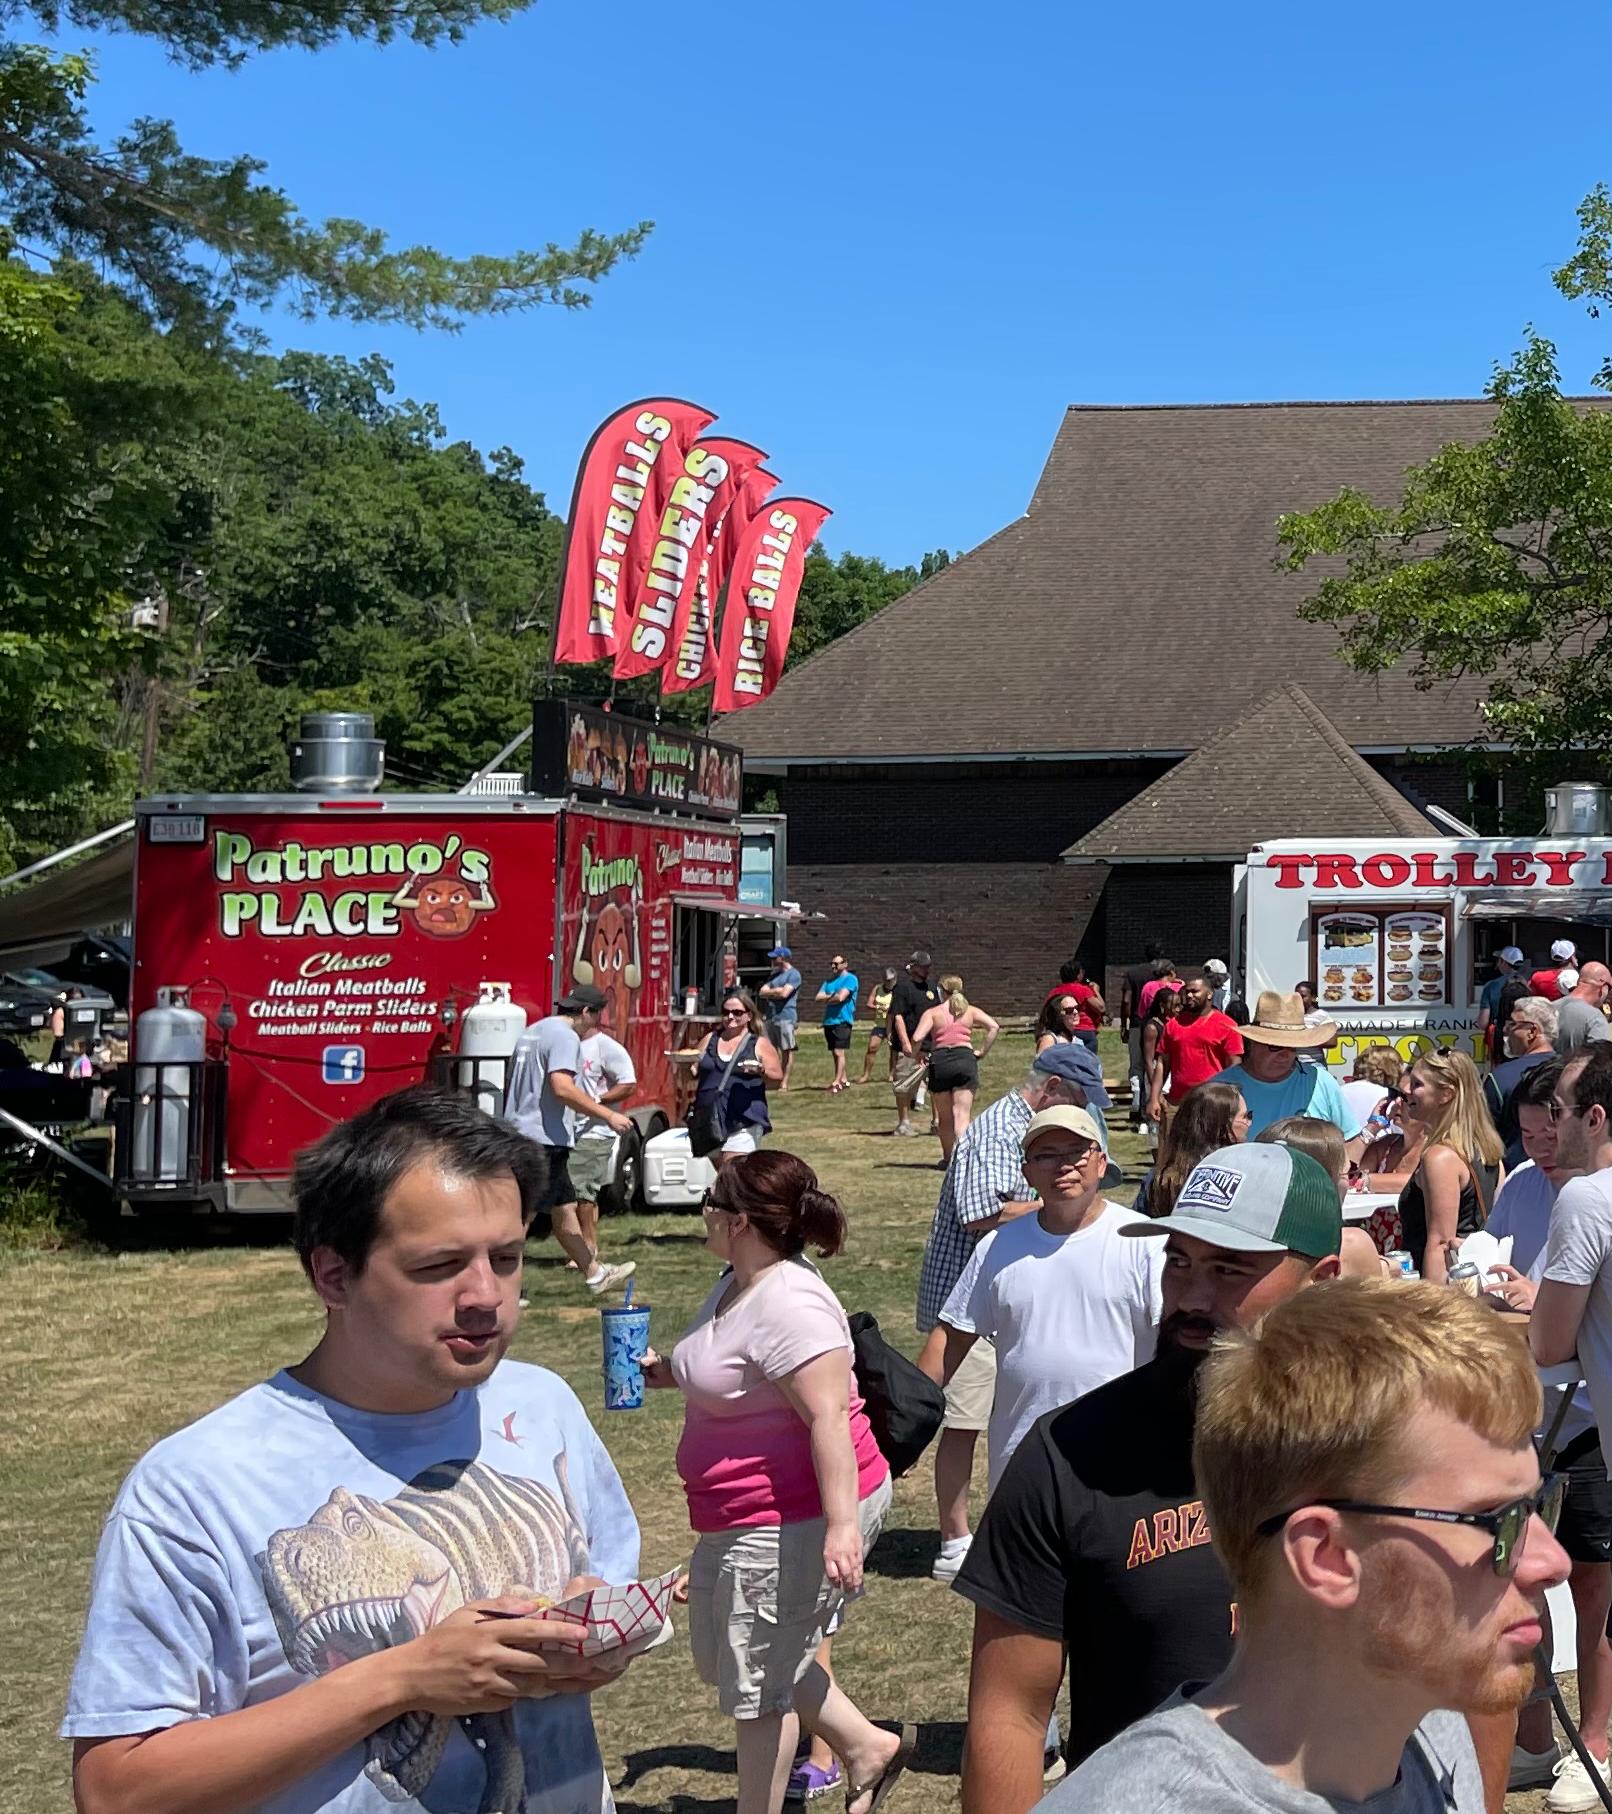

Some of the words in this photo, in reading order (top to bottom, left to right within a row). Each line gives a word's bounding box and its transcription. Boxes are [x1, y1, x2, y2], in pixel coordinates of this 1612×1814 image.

[588, 410, 672, 639] MEATBALLS
[631, 448, 729, 660] SLIDERS
[748, 508, 798, 612] BALLS
[733, 617, 769, 696] RICE
[651, 770, 685, 799] PLACE
[214, 830, 492, 883] Patruno's
[581, 843, 643, 899] Patruno's
[1266, 850, 1587, 889] TROLLEY
[220, 892, 402, 937] PLACE
[268, 979, 331, 996] Italian
[334, 977, 427, 996] Meatballs
[300, 952, 393, 978] Classic
[248, 1001, 318, 1018] Chicken
[322, 1000, 371, 1017] Parm
[376, 999, 438, 1016] Sliders
[257, 1022, 317, 1036] Meatball
[318, 1022, 361, 1035] Sliders
[371, 1021, 398, 1034] Rice
[400, 1020, 432, 1034] Balls
[1126, 1500, 1212, 1570] ARIZ
